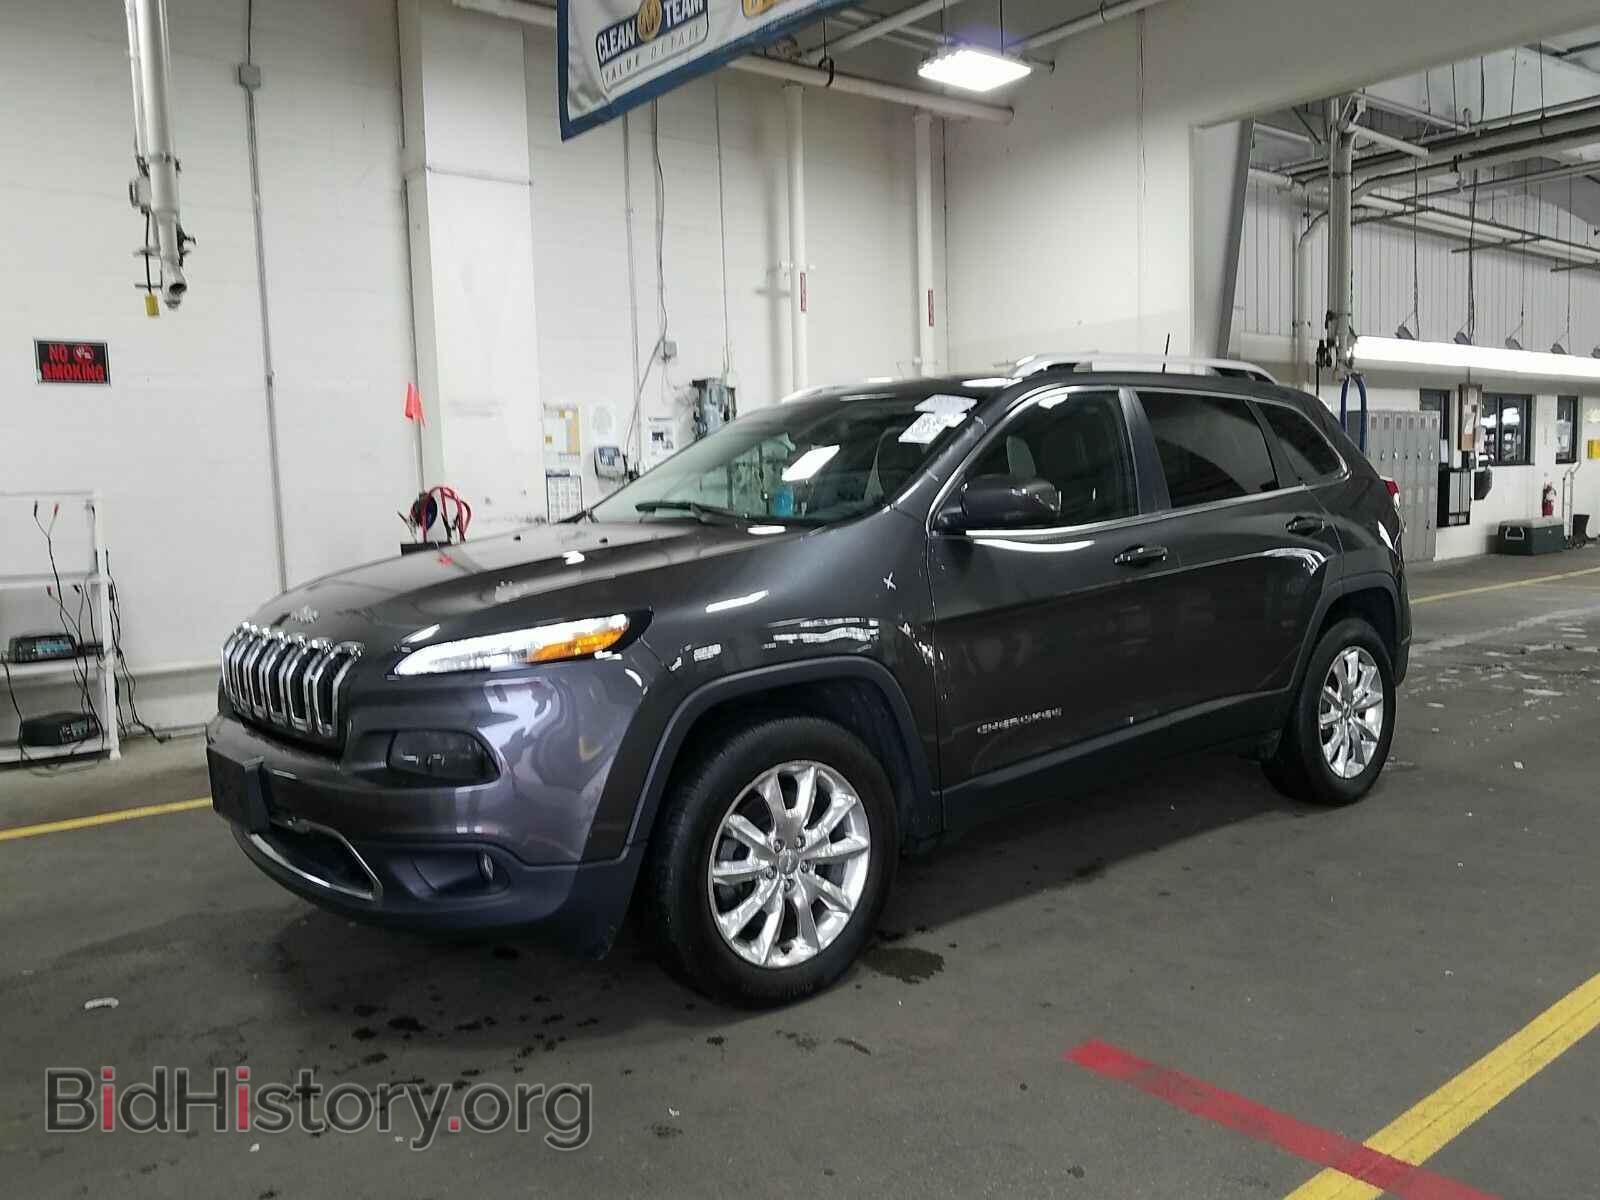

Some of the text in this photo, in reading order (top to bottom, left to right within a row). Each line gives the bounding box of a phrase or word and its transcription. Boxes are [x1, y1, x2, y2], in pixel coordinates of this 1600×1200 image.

[597, 18, 636, 63] CLEAN
[601, 53, 641, 86] VALUE
[48, 343, 68, 362] NO
[42, 361, 105, 382] SMOKING
